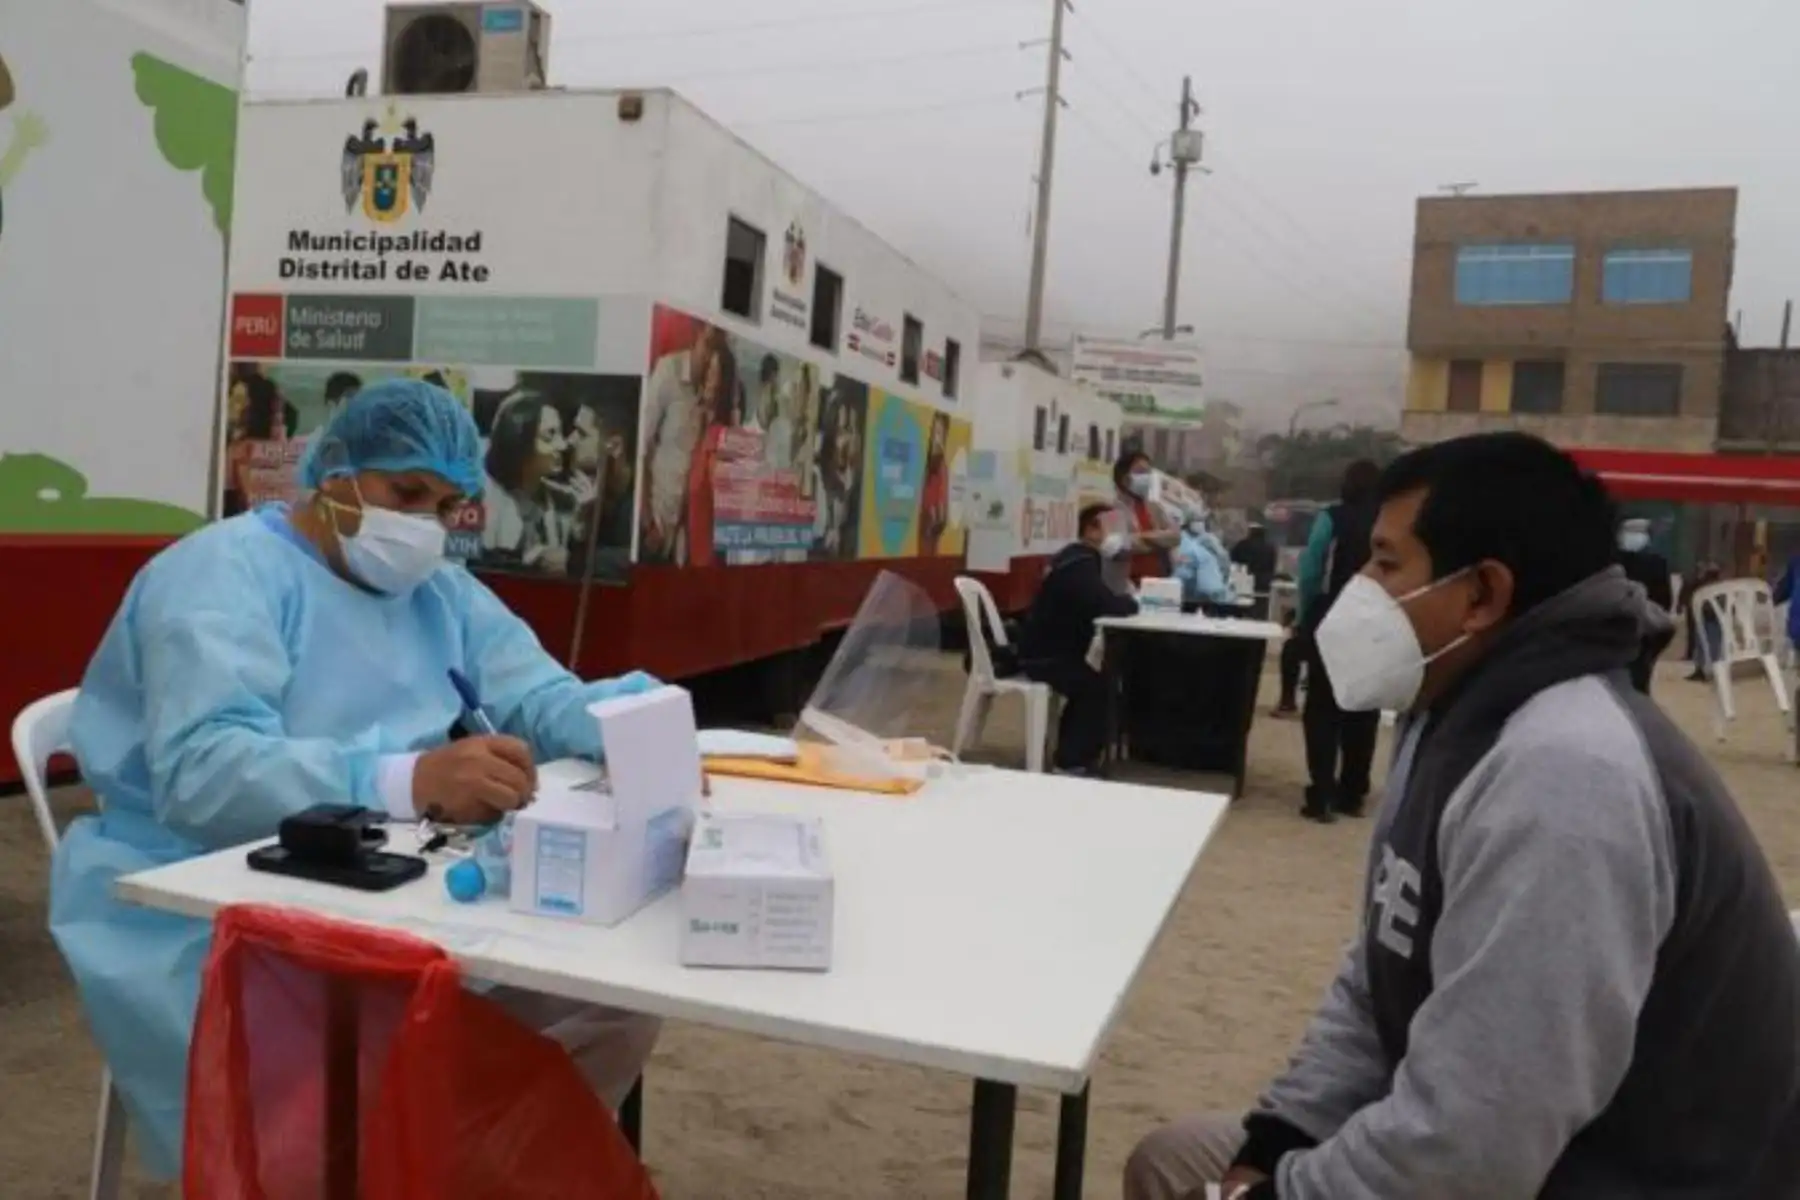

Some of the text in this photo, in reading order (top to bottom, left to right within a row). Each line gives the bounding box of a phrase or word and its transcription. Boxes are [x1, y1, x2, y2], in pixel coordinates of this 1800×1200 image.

[288, 230, 482, 256] Municipalidad
[278, 257, 490, 282] Distrital de Ate
[235, 312, 278, 338] PERÚ
[289, 307, 382, 329] Ministerio
[289, 329, 312, 348] de
